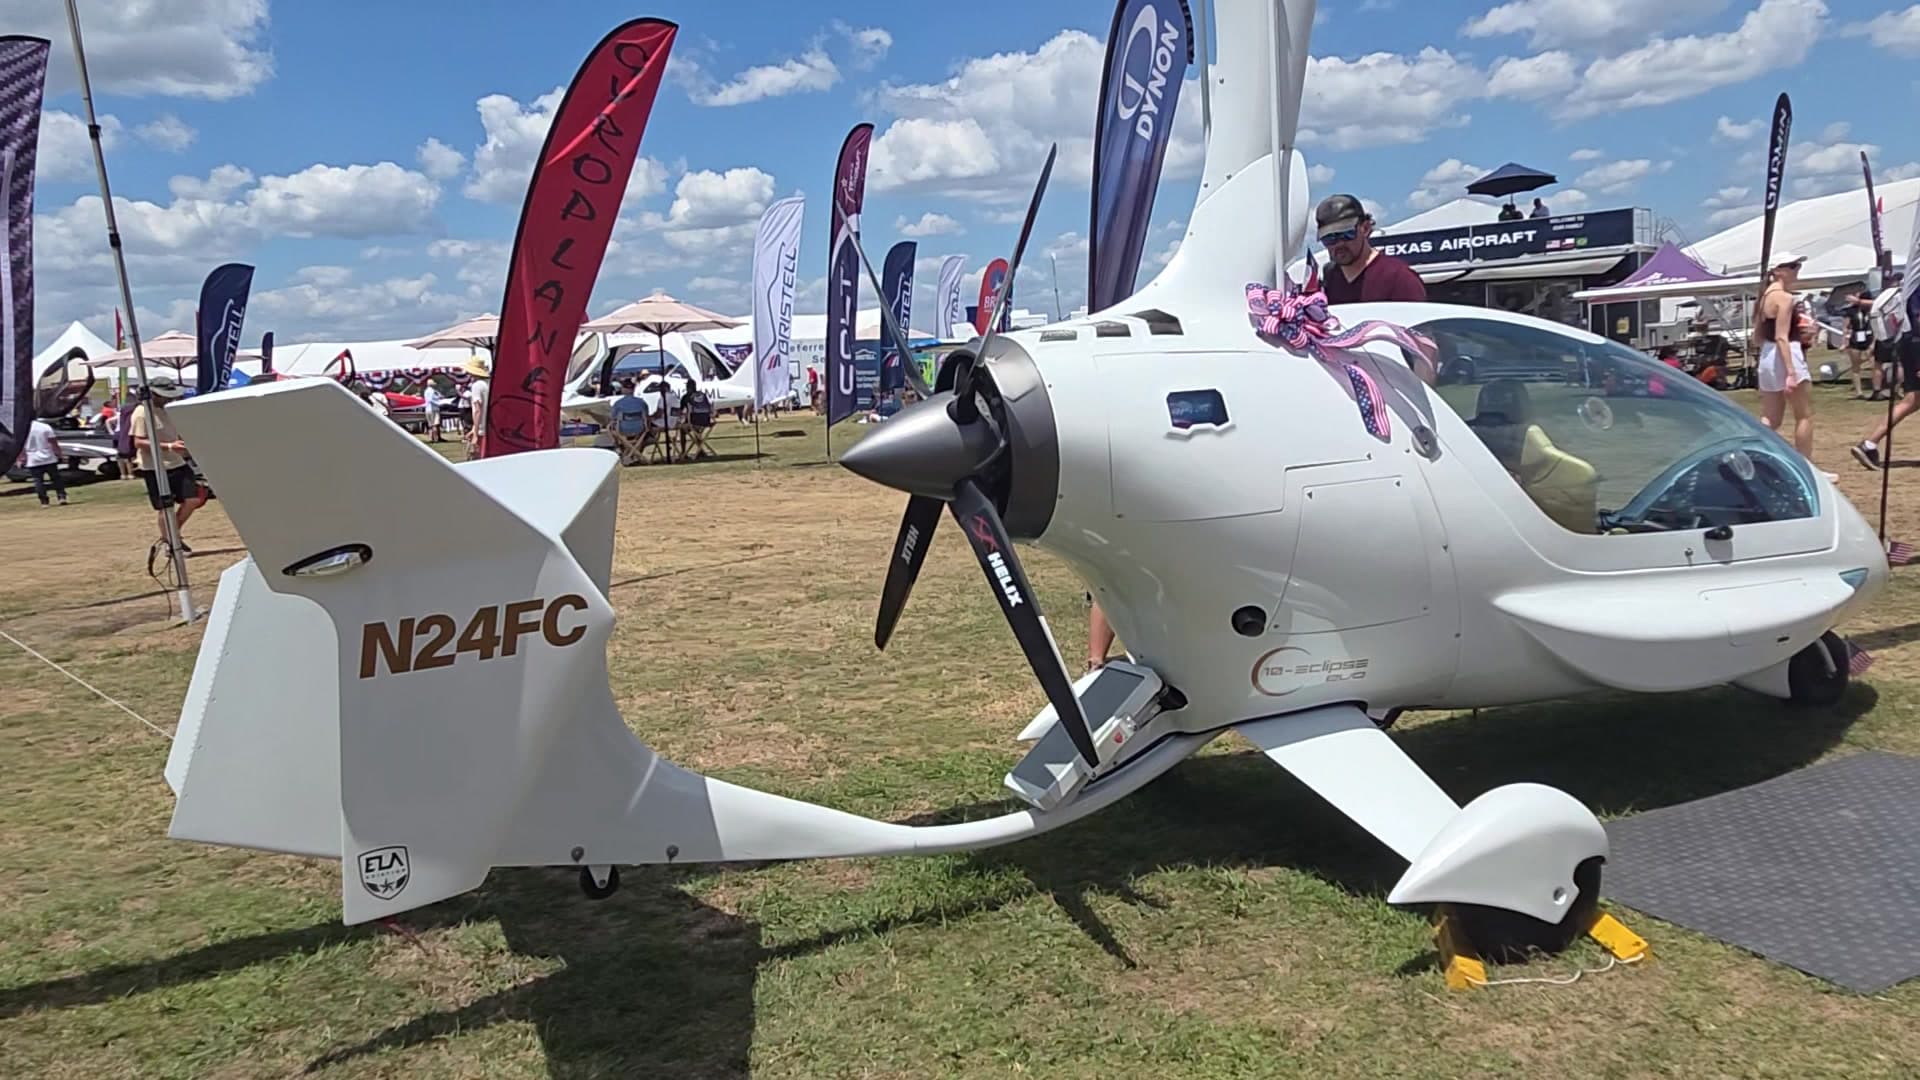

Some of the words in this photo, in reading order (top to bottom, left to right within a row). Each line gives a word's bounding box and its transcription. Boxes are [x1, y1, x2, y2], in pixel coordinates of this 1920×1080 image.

[1136, 20, 1180, 141] DYNON
[1766, 108, 1787, 210] GARMIN
[1440, 230, 1537, 251] AIRCRAFT
[777, 246, 797, 356] BRISTELL
[899, 275, 913, 341] ISTELL
[219, 305, 246, 389] RISTELL
[900, 524, 920, 566] HELIX
[987, 551, 1024, 608] HELIX
[359, 593, 589, 679] N24FC
[365, 851, 405, 873] ELA
